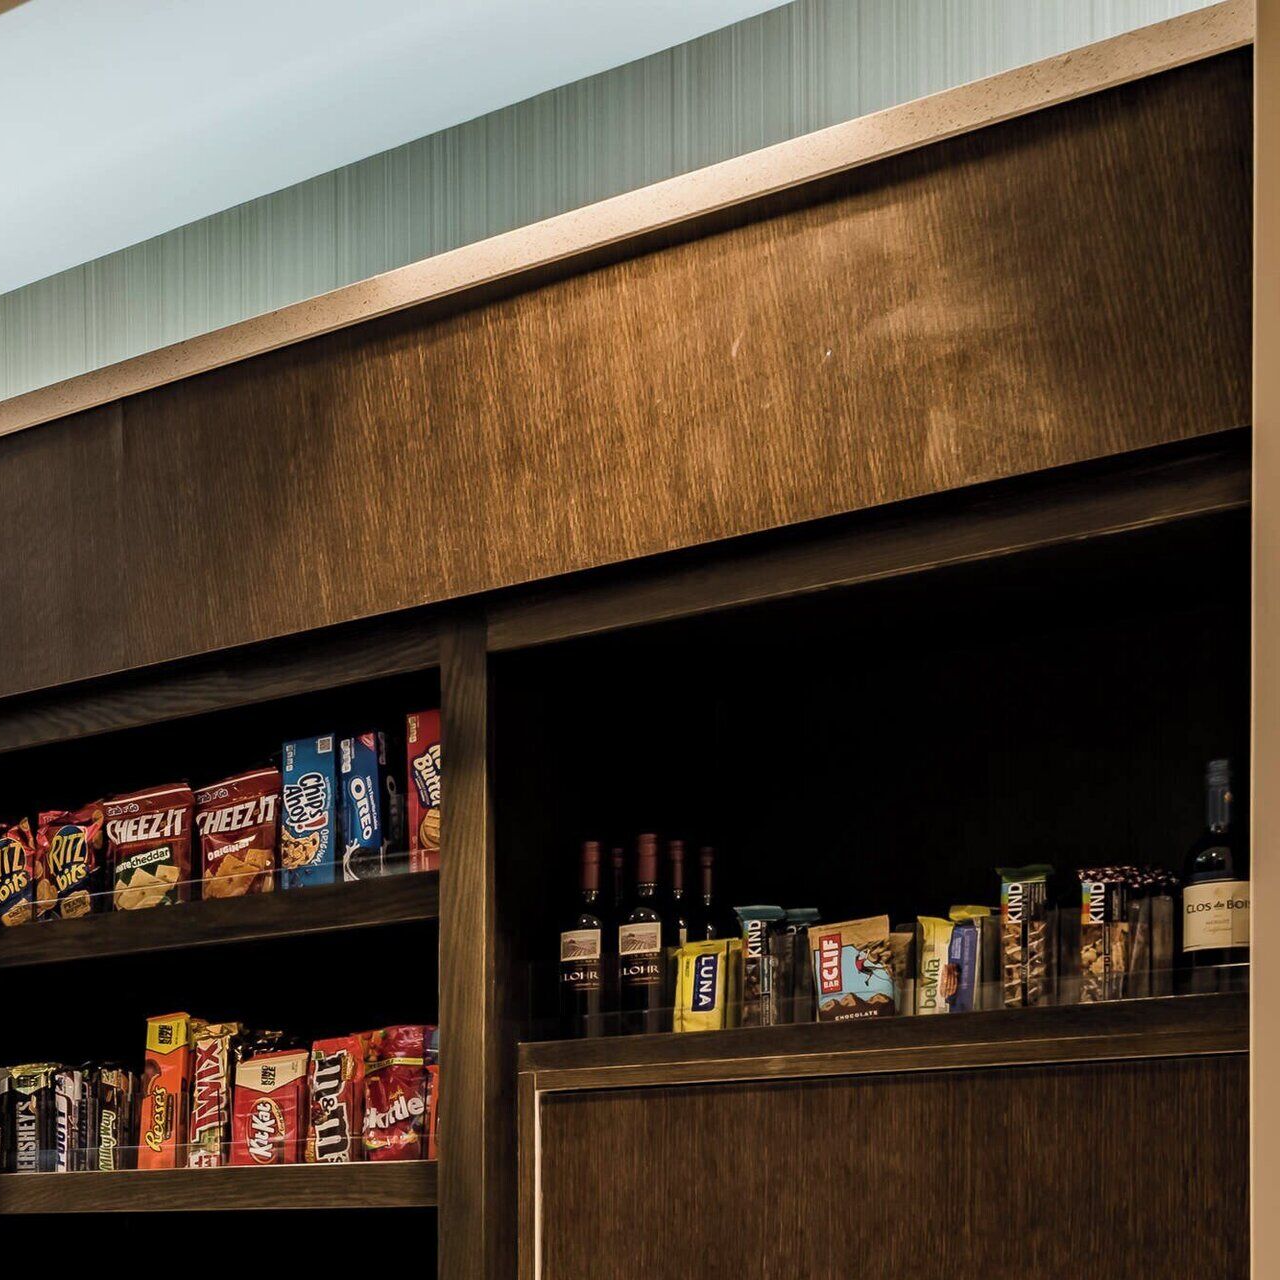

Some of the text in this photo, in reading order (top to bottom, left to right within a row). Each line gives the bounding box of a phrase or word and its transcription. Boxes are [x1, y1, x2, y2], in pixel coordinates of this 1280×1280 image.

[297, 772, 326, 820] Chips
[350, 777, 372, 840] OREO
[49, 833, 88, 877] RITZ
[130, 848, 170, 869] cheddar
[56, 863, 87, 892] bits
[1008, 883, 1023, 924] KIND
[1089, 882, 1105, 924] KIND
[1186, 902, 1211, 914] CLOS
[747, 920, 762, 958] KIND
[623, 965, 659, 975] LOHR
[822, 940, 839, 980] CLIF
[698, 955, 713, 1007] LUNA
[921, 958, 940, 1010] belvita
[835, 1010, 878, 1021] CHOCOLATE
[191, 1041, 222, 1144] TWIX
[260, 1065, 268, 1086] KING
[268, 1066, 276, 1087] SIZE
